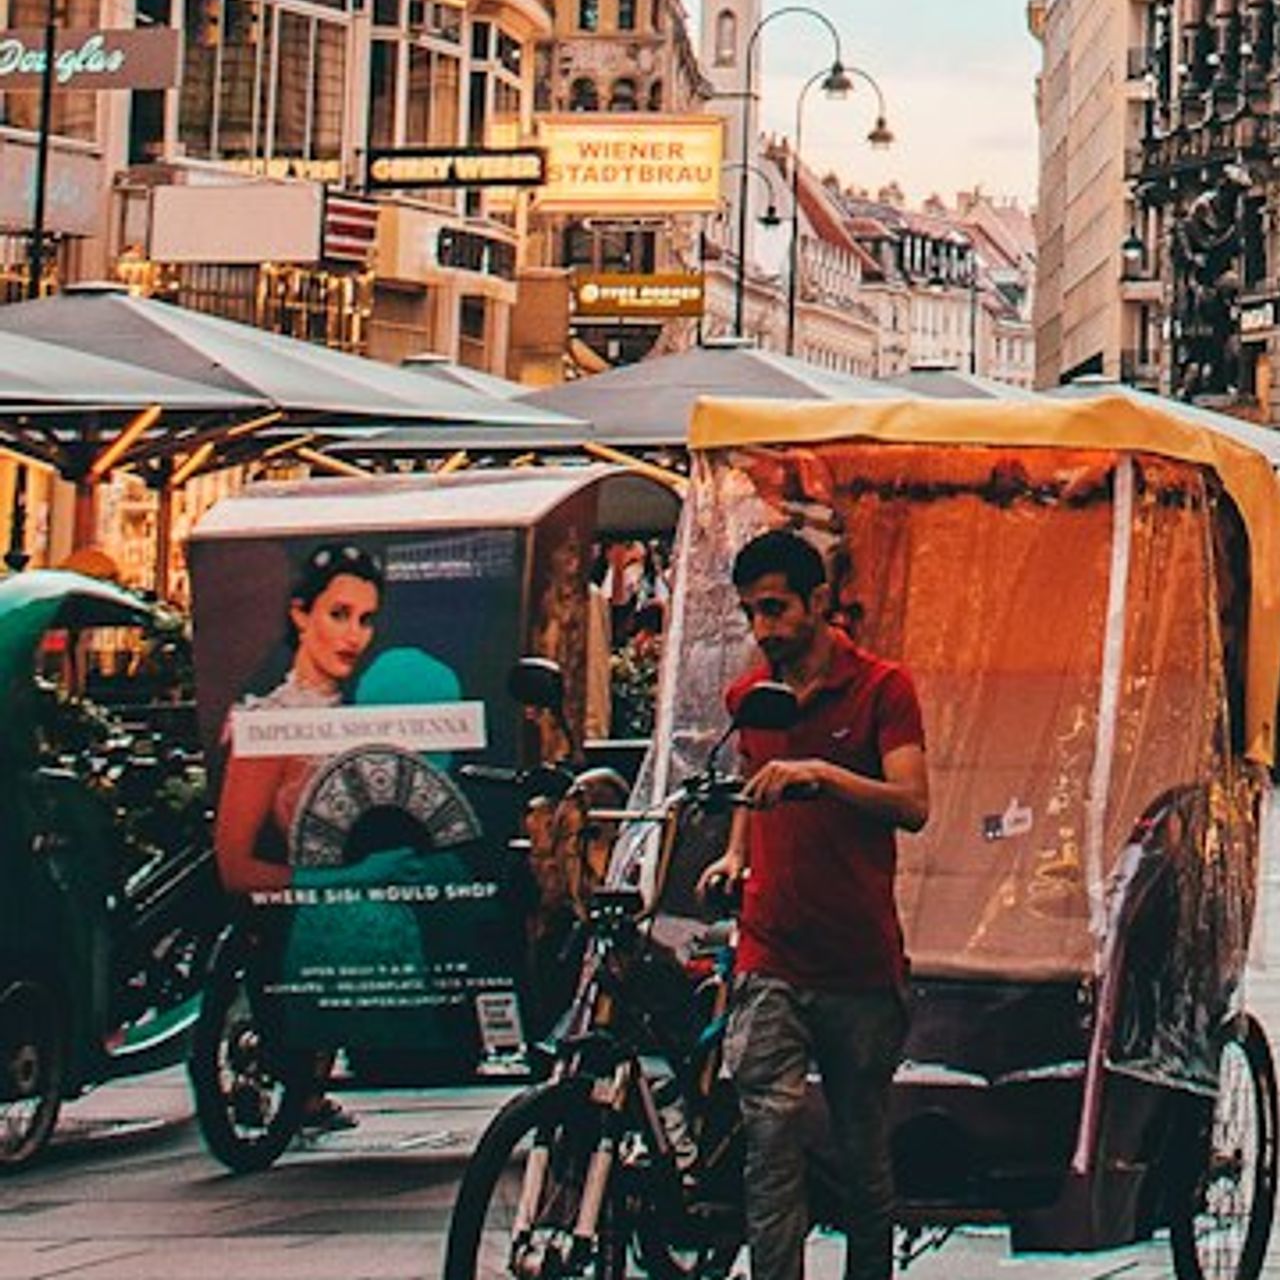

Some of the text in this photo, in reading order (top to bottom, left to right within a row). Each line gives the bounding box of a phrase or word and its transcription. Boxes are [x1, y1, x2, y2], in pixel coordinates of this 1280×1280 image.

[577, 141, 686, 160] WIENER
[252, 889, 317, 905] WHERE
[367, 886, 438, 903] WOULD
[444, 883, 498, 899] SHOP
